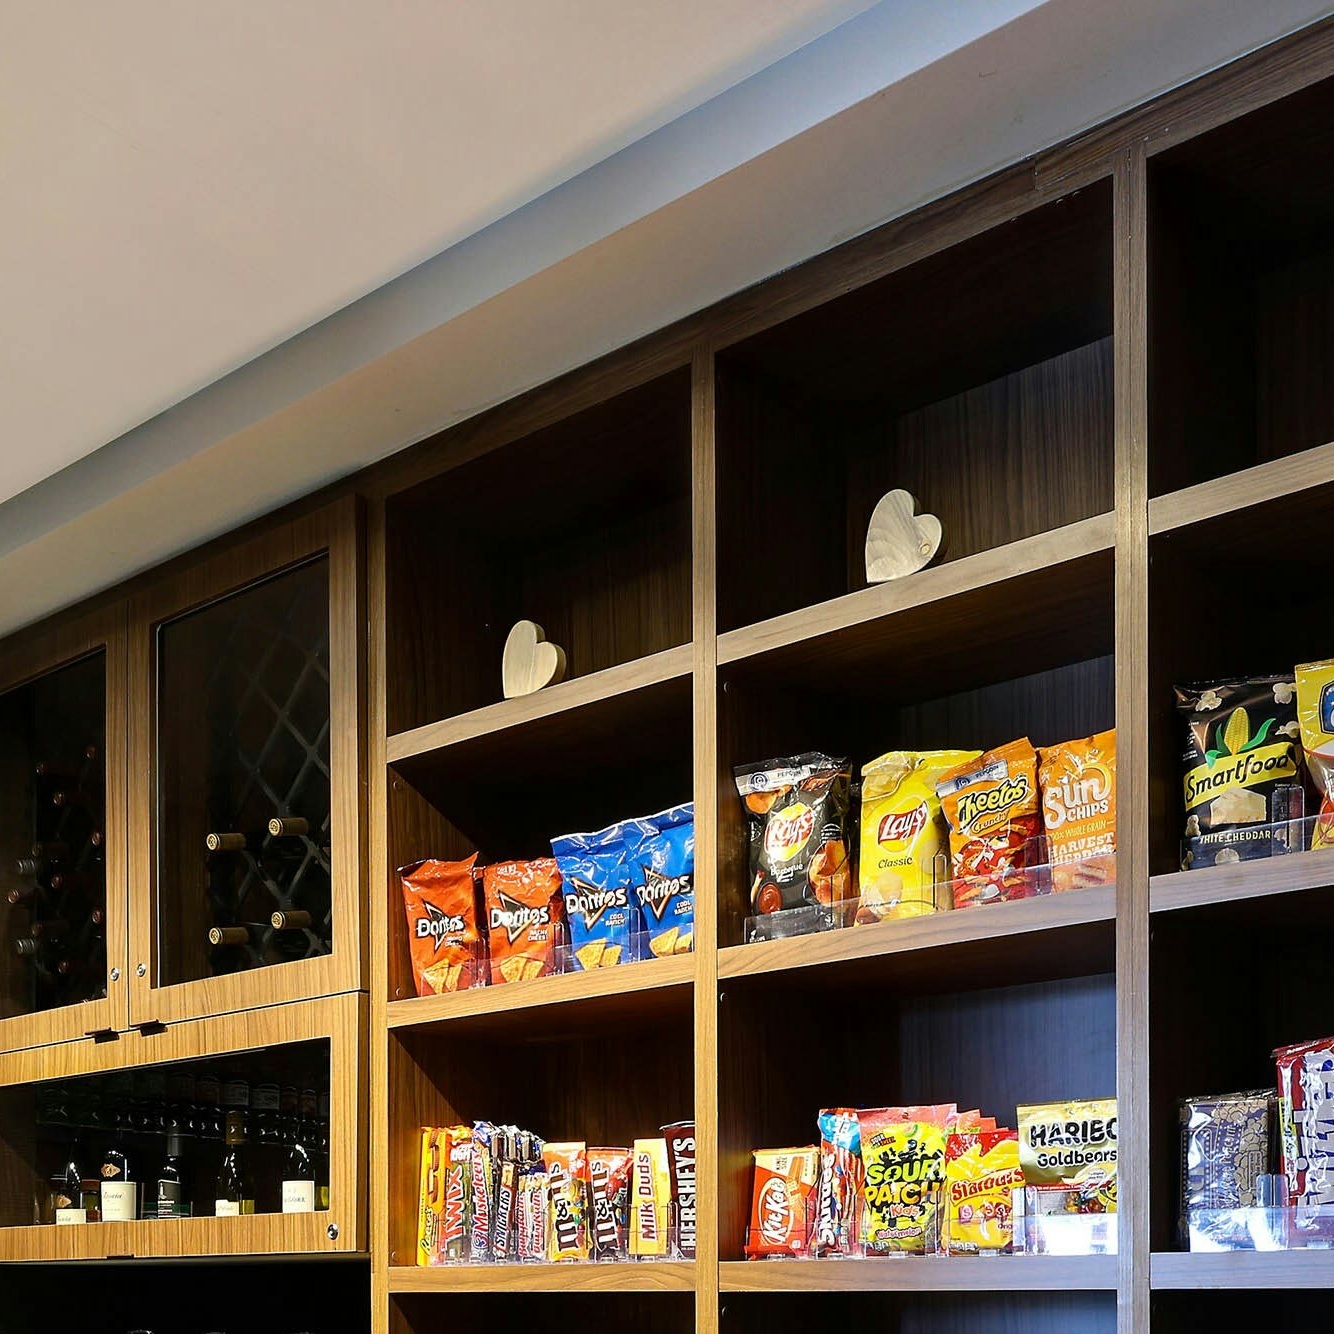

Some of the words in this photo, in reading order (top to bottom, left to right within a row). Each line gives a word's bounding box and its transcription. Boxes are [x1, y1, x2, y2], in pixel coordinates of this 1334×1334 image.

[1186, 752, 1289, 802] Smartfood
[1067, 800, 1109, 822] CHIPS
[1227, 830, 1271, 843] CHEDDAR
[878, 856, 913, 869] Classic
[565, 888, 627, 913] Doritos
[637, 875, 689, 905] Doritos
[417, 915, 465, 938] Doritos
[490, 905, 549, 928] Doritos
[1038, 1149, 1117, 1168] Goldbears
[639, 1153, 651, 1197] Duds
[444, 1166, 465, 1241] TWIX
[494, 1189, 511, 1249] SNICKERS
[640, 1200, 657, 1241] Milk
